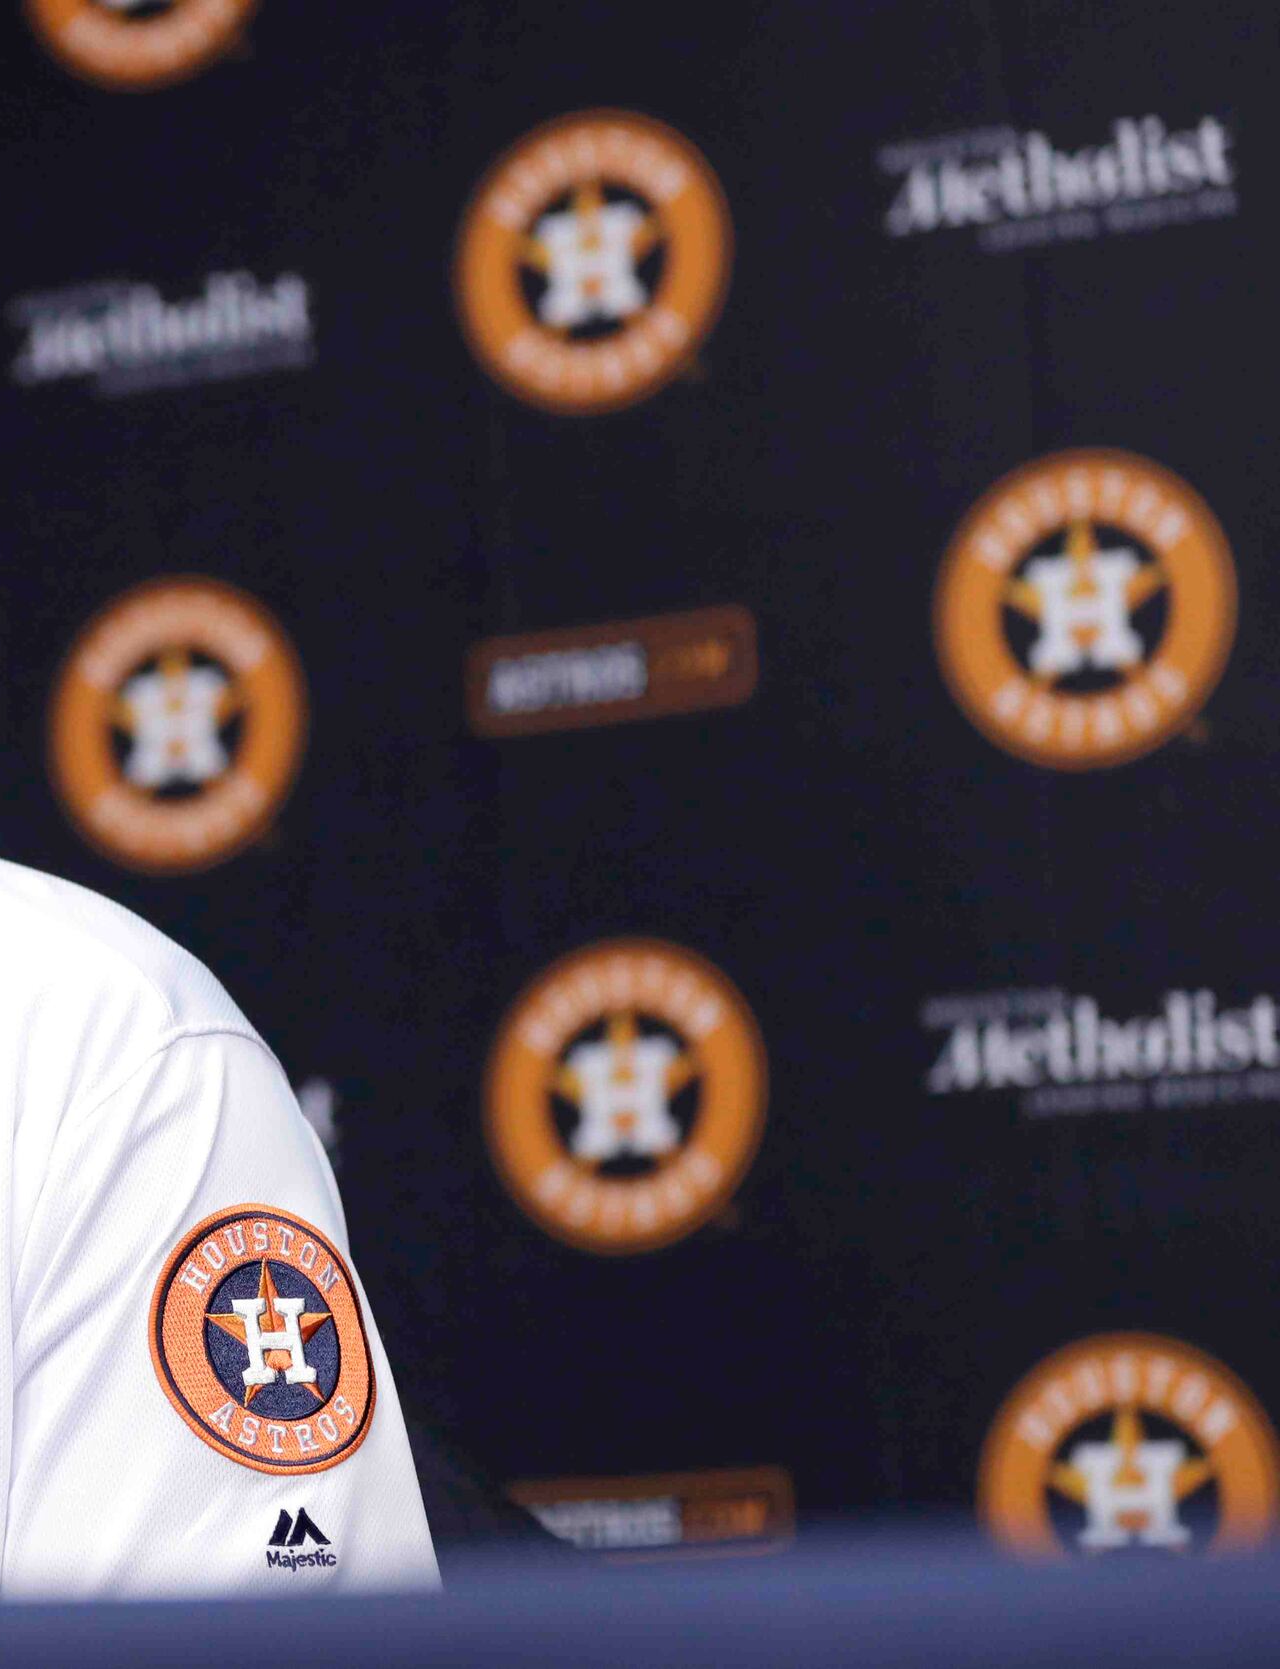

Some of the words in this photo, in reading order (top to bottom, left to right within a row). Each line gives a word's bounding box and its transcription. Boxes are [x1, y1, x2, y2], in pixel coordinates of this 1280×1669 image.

[1022, 547, 1146, 675] H
[566, 1034, 682, 1160] H
[181, 1220, 344, 1295] HOUSTON
[231, 1296, 318, 1386] H
[208, 1394, 358, 1455] ASTROS
[1068, 1438, 1192, 1550] H
[265, 1548, 338, 1572] Majestic
